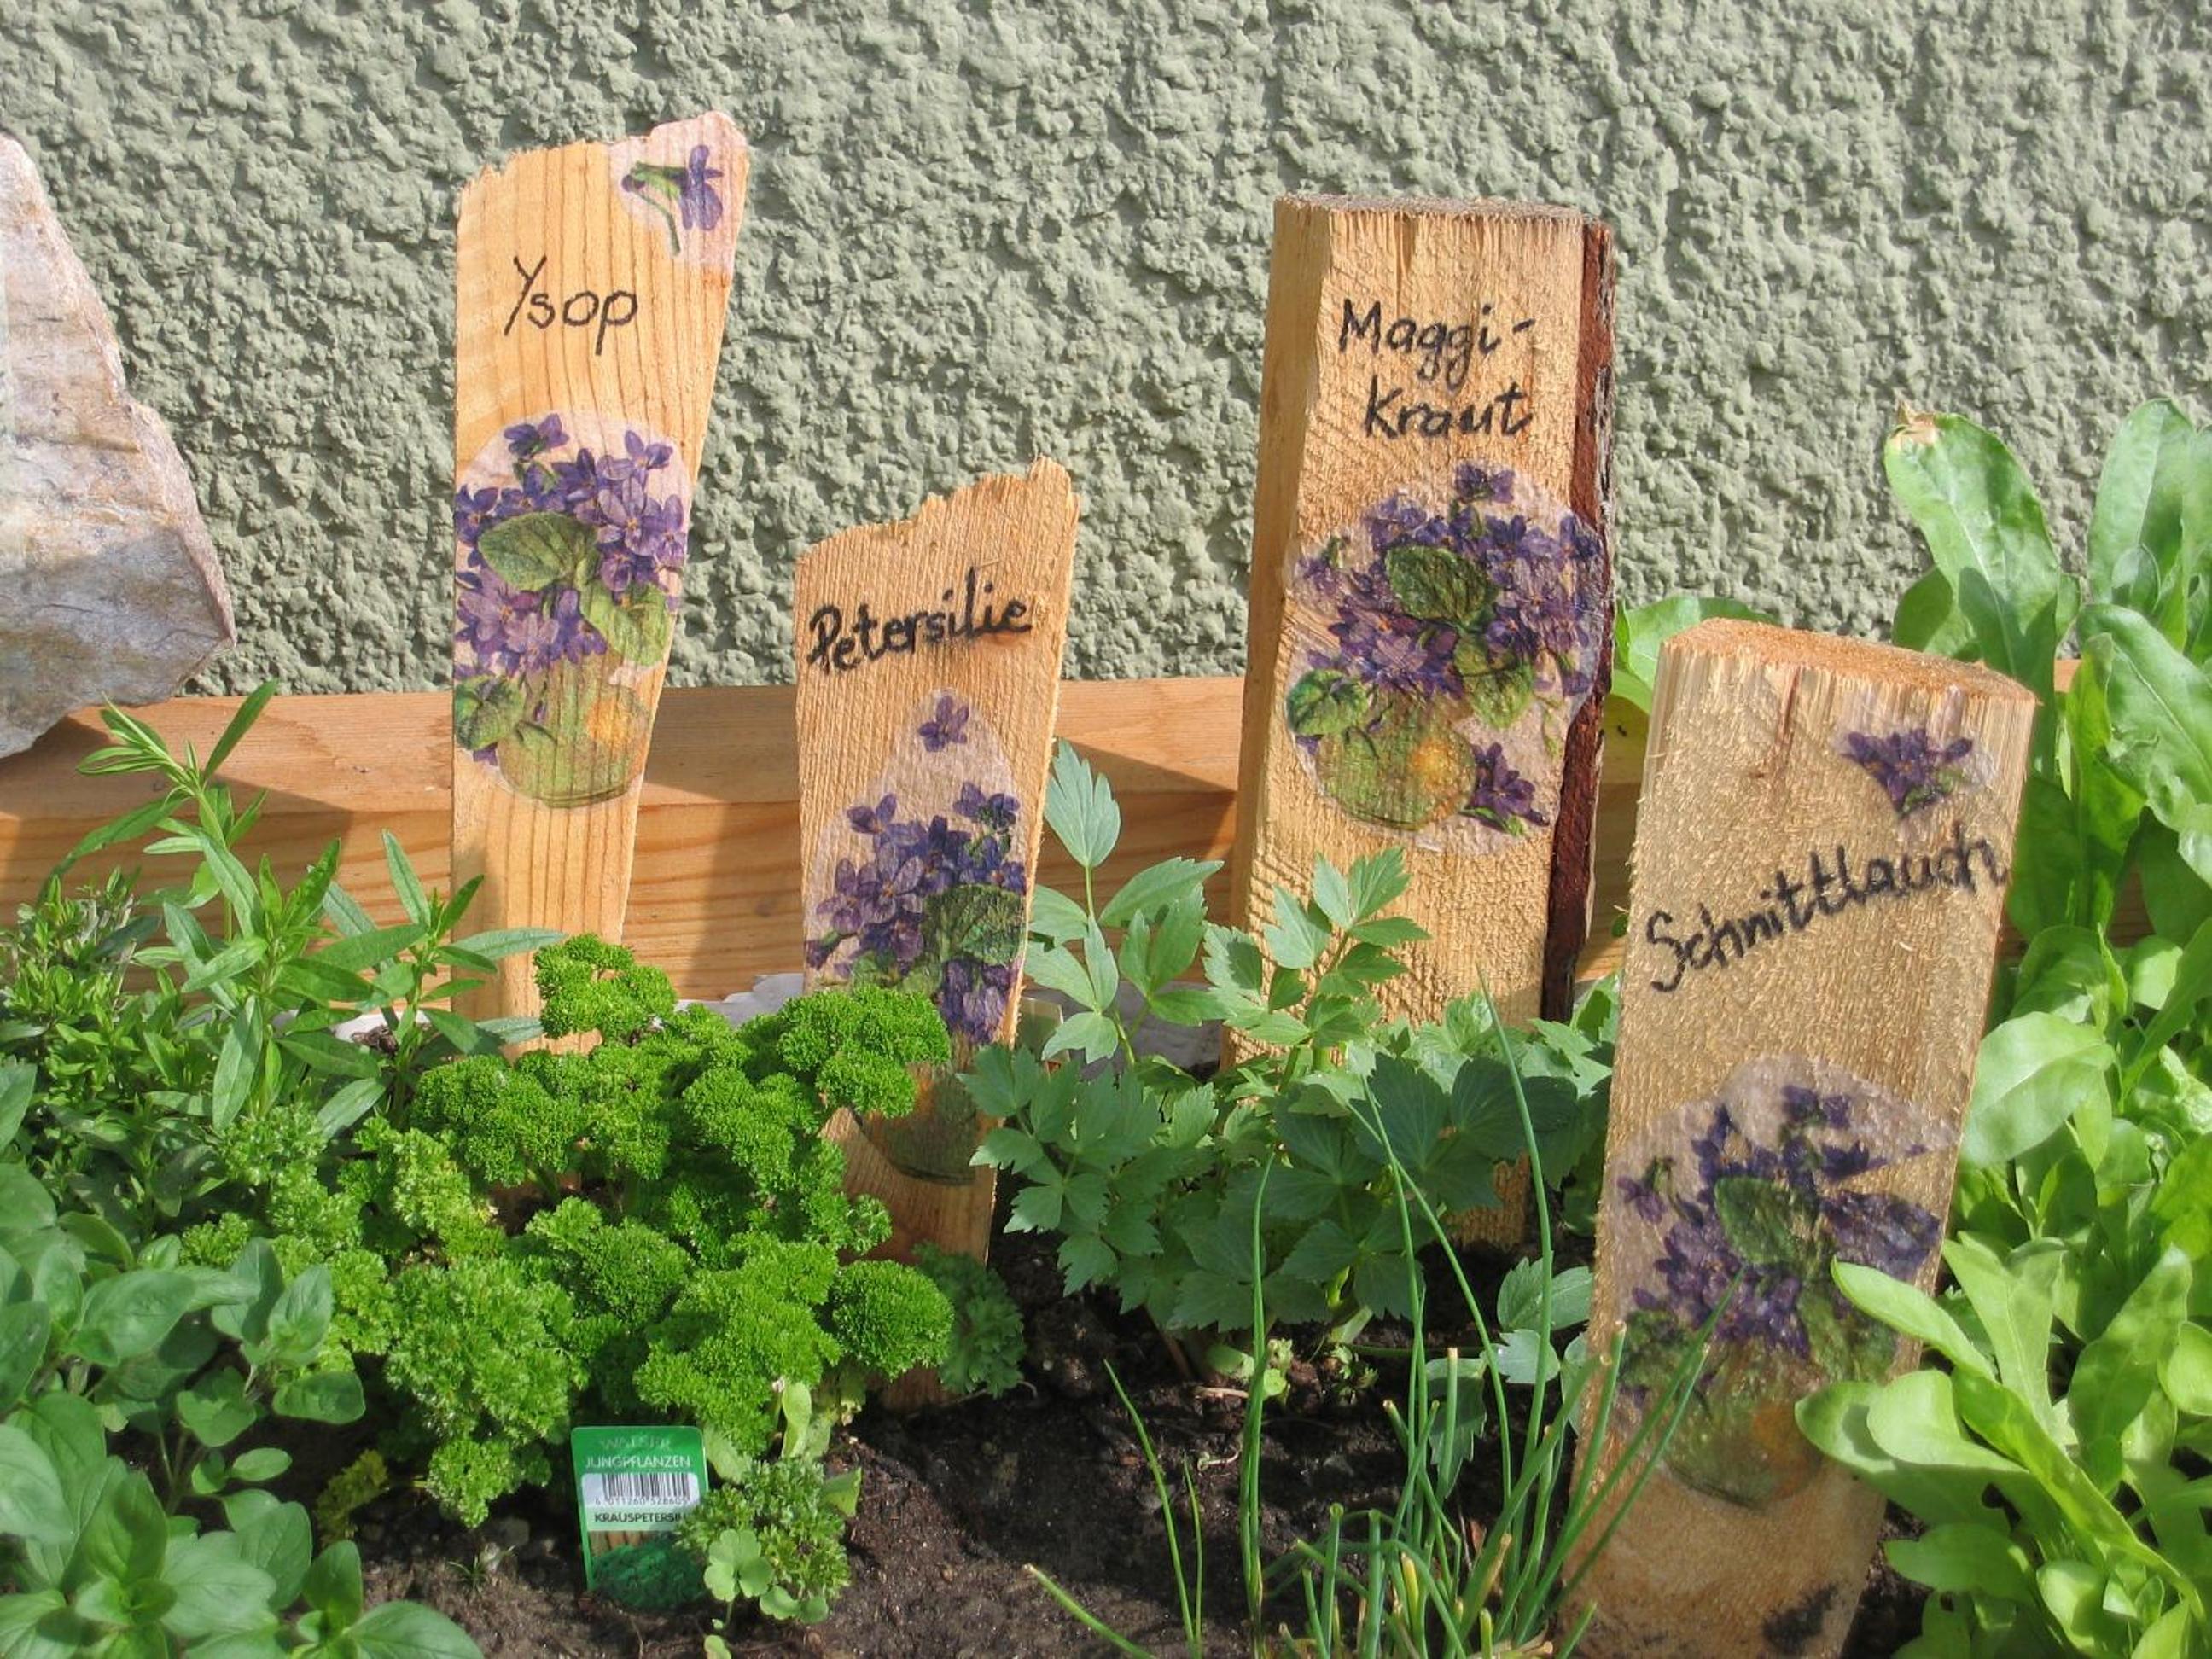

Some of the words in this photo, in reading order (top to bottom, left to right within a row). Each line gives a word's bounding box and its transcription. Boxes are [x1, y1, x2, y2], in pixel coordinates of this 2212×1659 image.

[504, 254, 638, 356] Ysop
[1338, 298, 1535, 393] Maggi-
[1365, 375, 1533, 439] Kraut
[806, 565, 1033, 676] Petersilie
[1646, 820, 2008, 993] Schnittlauch
[585, 1455, 691, 1469] JUNGPFLANZEN
